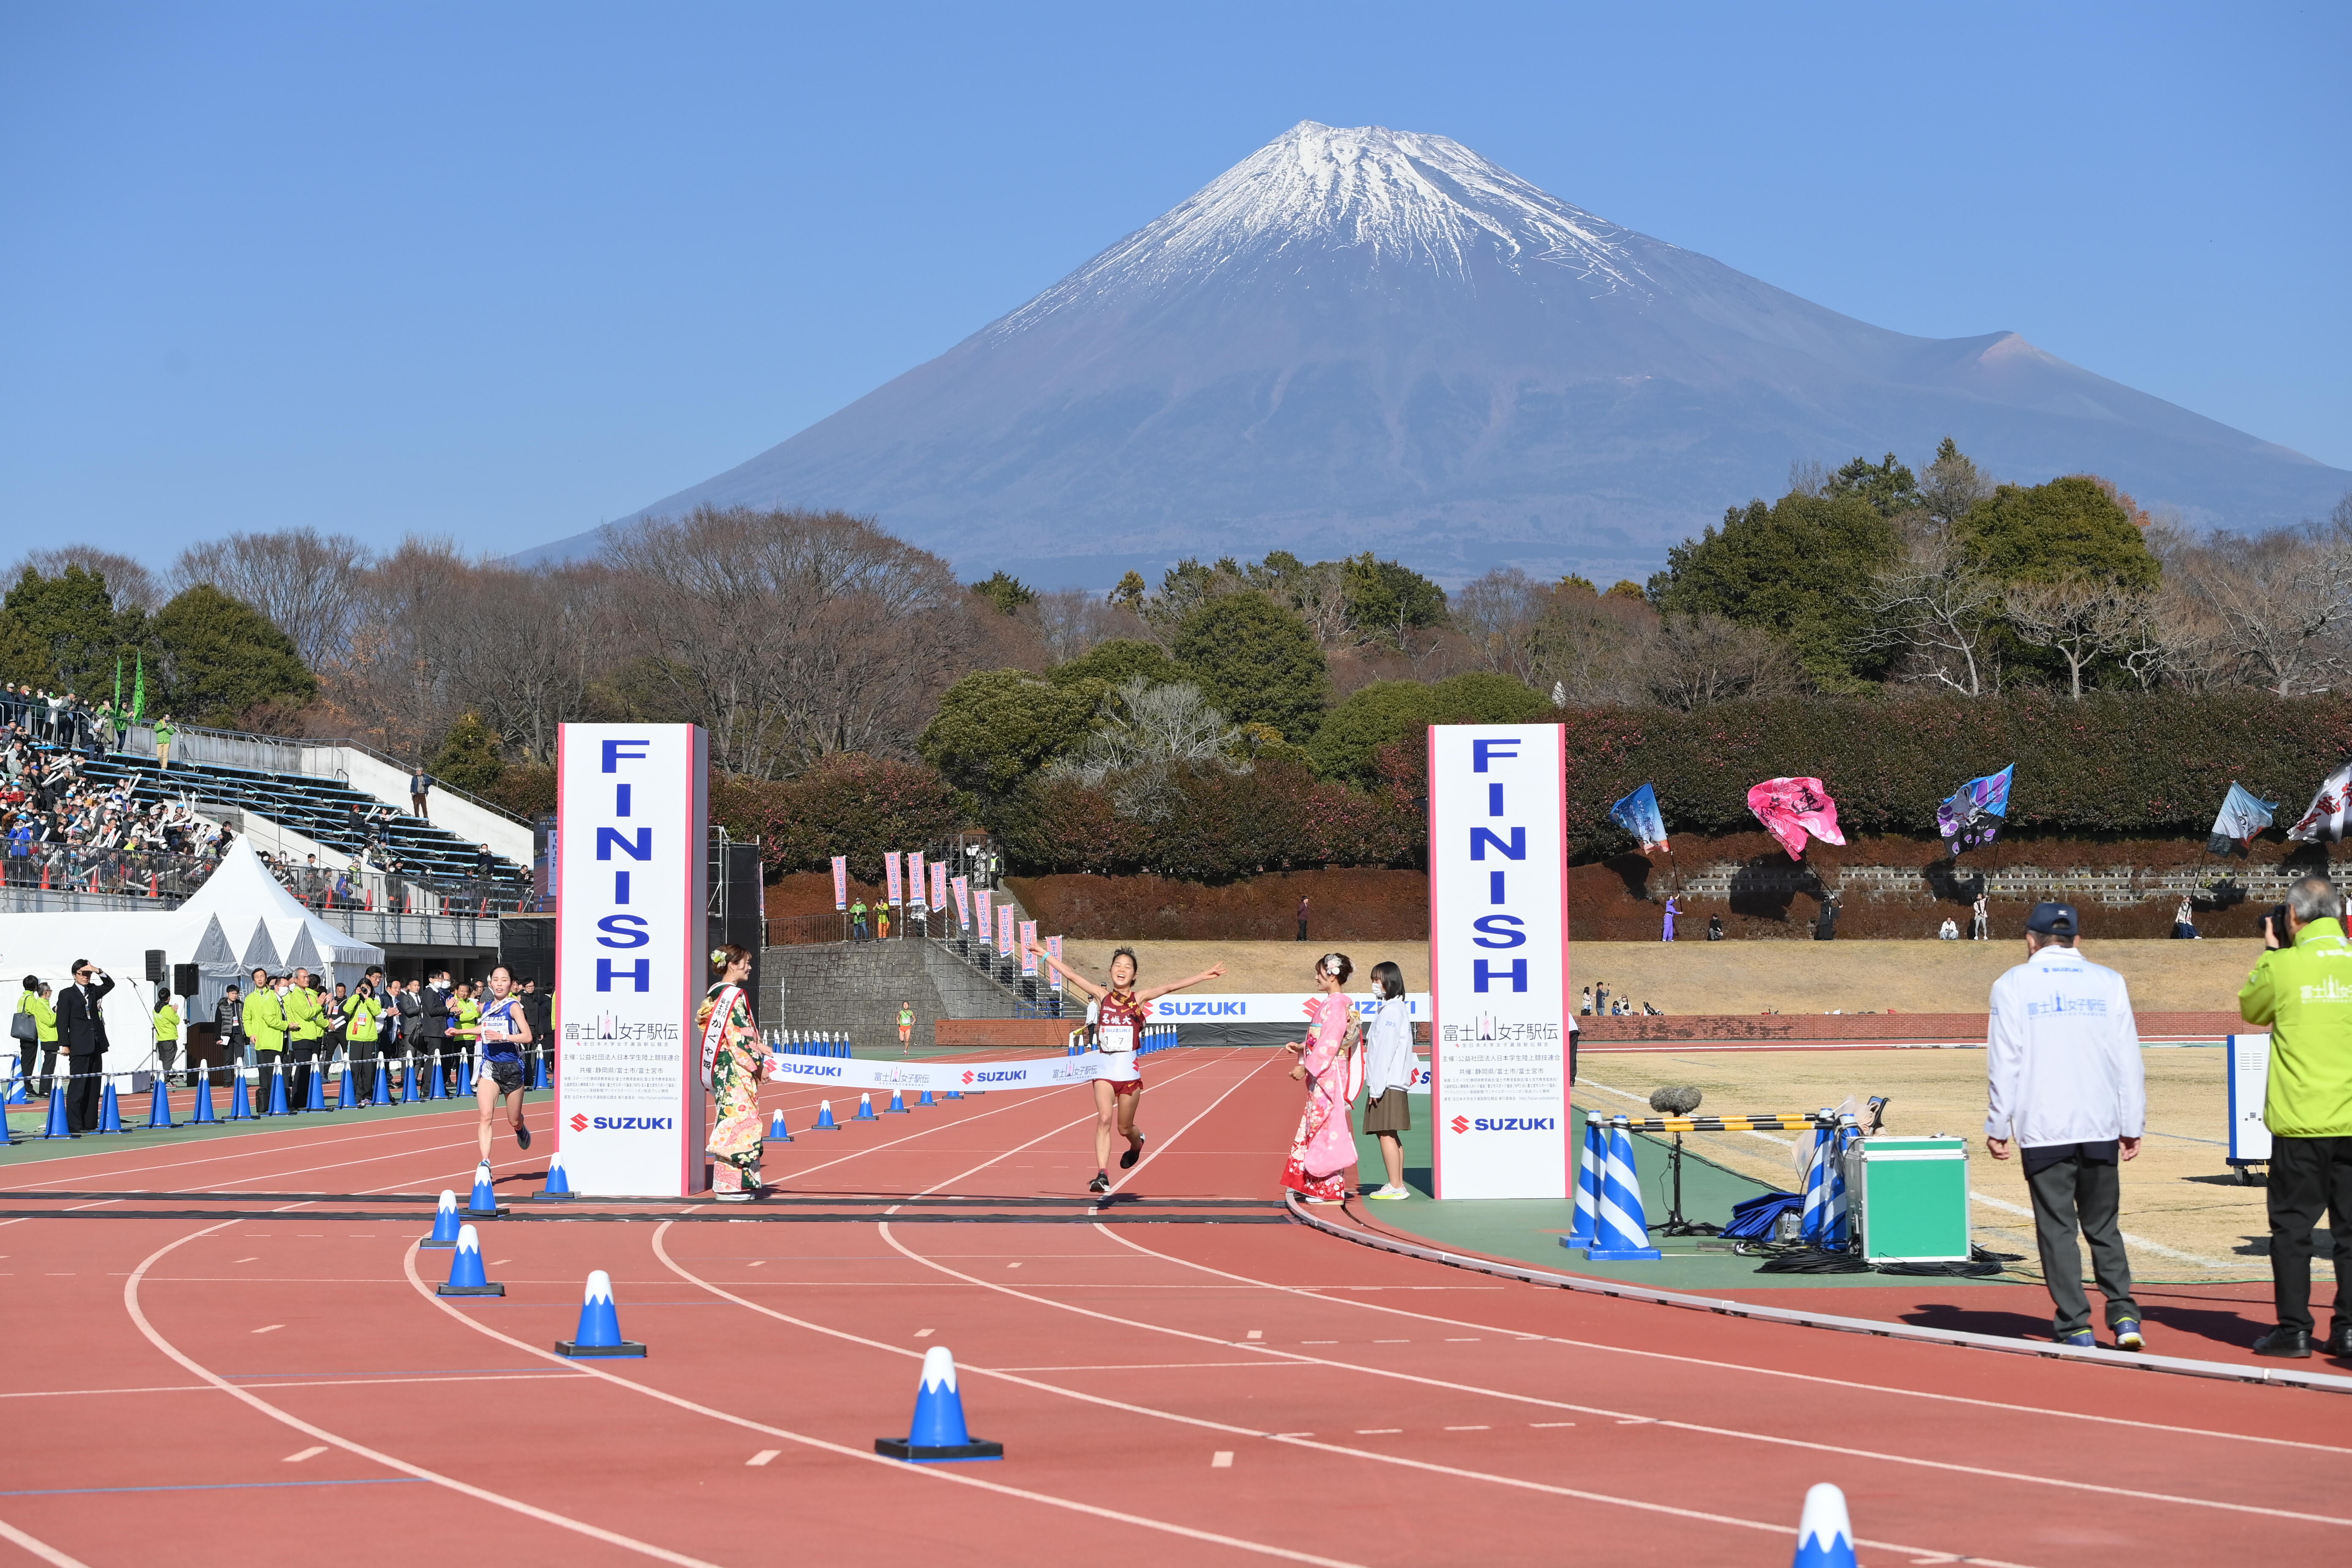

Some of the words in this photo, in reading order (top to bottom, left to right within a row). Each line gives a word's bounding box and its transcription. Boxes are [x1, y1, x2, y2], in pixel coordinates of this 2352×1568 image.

[596, 740, 652, 992] FINISH
[1470, 739, 1527, 993] FINISH
[716, 997, 726, 1016] 富士市
[1159, 1002, 1246, 1015] SUZUKI
[2028, 990, 2106, 1015] 富士山女子駅伝
[565, 1010, 678, 1040] 富士山女子駅伝
[1102, 1013, 1132, 1025] 名城大
[1443, 1010, 1558, 1041] 富士山女子駅伝
[703, 1018, 721, 1070] かぐや姫
[781, 1063, 841, 1077] SUZUKI
[874, 1066, 930, 1083] 富士山女子駅伝
[977, 1070, 1026, 1082] SUZUKI
[1053, 1060, 1097, 1079] 富士山女子駅伝
[593, 1117, 672, 1130] SUZUKI
[1475, 1118, 1554, 1130] SUZUKI
